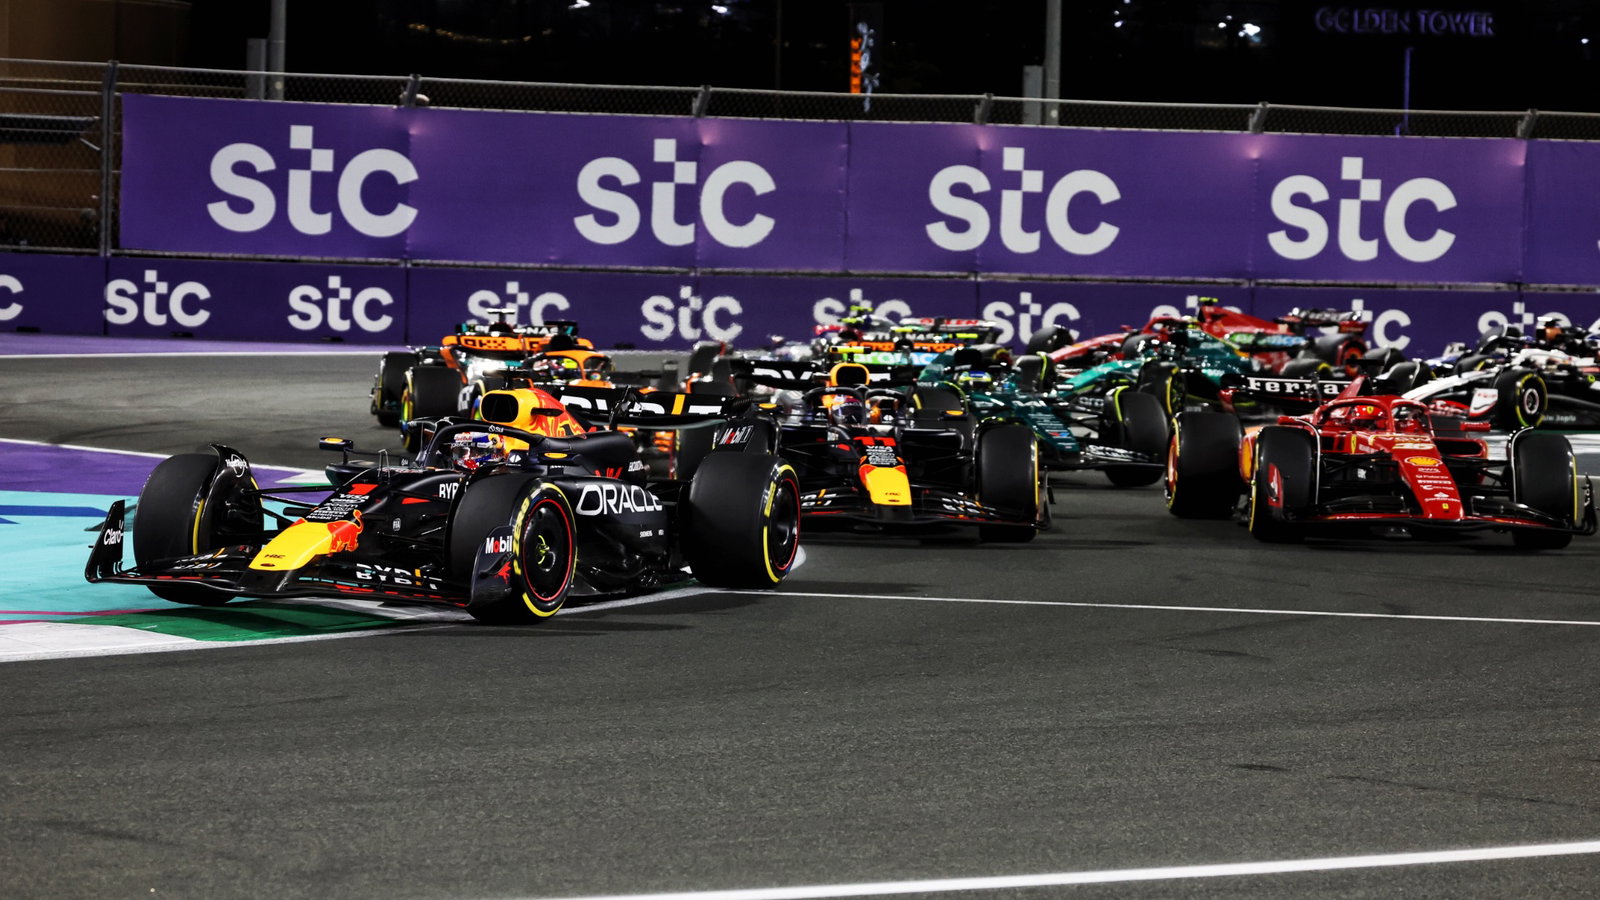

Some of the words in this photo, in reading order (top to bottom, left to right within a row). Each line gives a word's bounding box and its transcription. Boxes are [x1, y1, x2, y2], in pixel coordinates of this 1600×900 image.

[1417, 9, 1495, 37] TOWER
[207, 125, 419, 237] stc
[574, 138, 777, 249] stc
[925, 147, 1122, 256] stc
[1268, 157, 1458, 263] stc
[103, 270, 212, 329] stc
[287, 276, 394, 333] stc
[641, 286, 744, 343] stc
[982, 292, 1080, 346] stc
[853, 352, 938, 366] aramc
[1247, 377, 1352, 396] Ferra
[103, 528, 122, 546] Claro
[485, 535, 513, 555] Mobil
